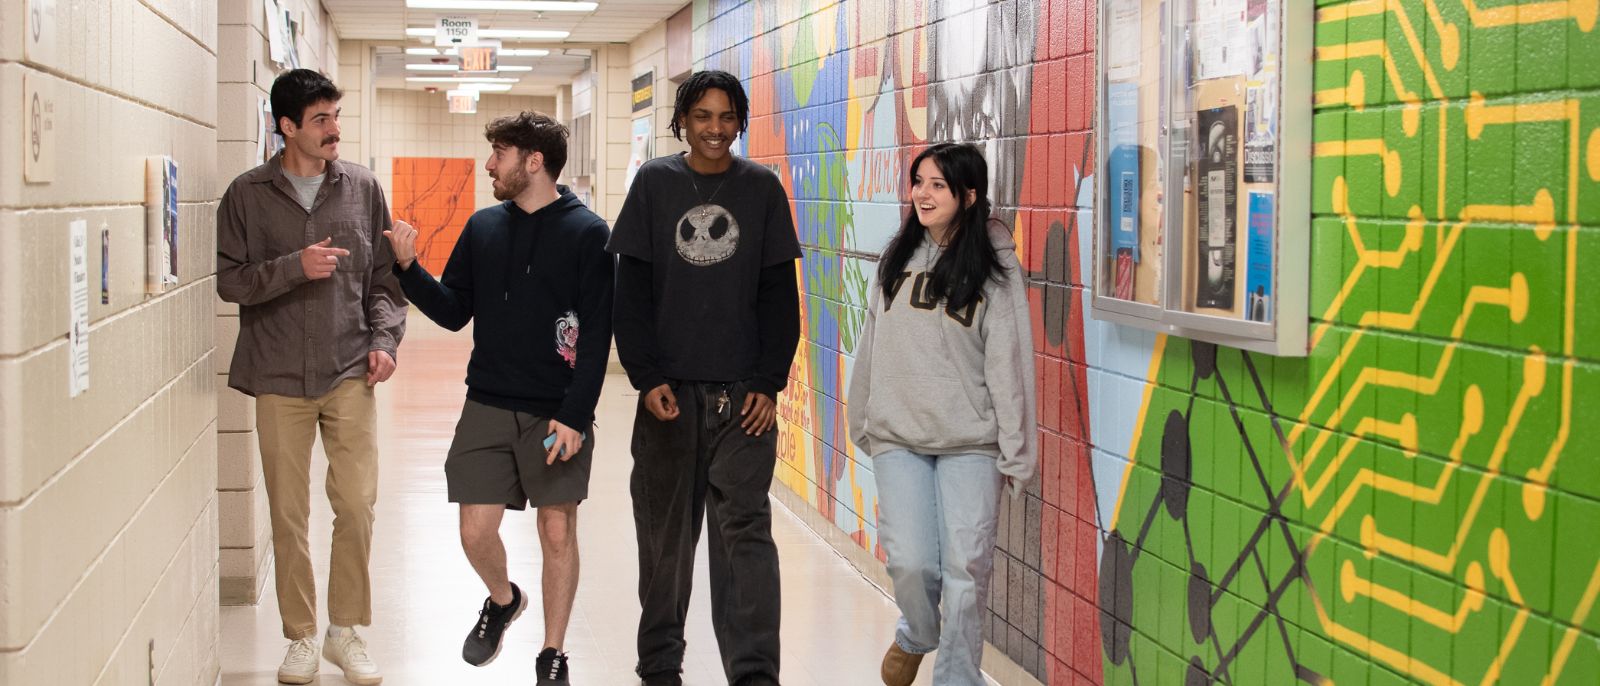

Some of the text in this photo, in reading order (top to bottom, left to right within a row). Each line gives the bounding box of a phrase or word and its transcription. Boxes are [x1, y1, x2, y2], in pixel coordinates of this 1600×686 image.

[441, 18, 472, 28] Room
[446, 28, 468, 36] 1150
[463, 47, 491, 71] EXIT
